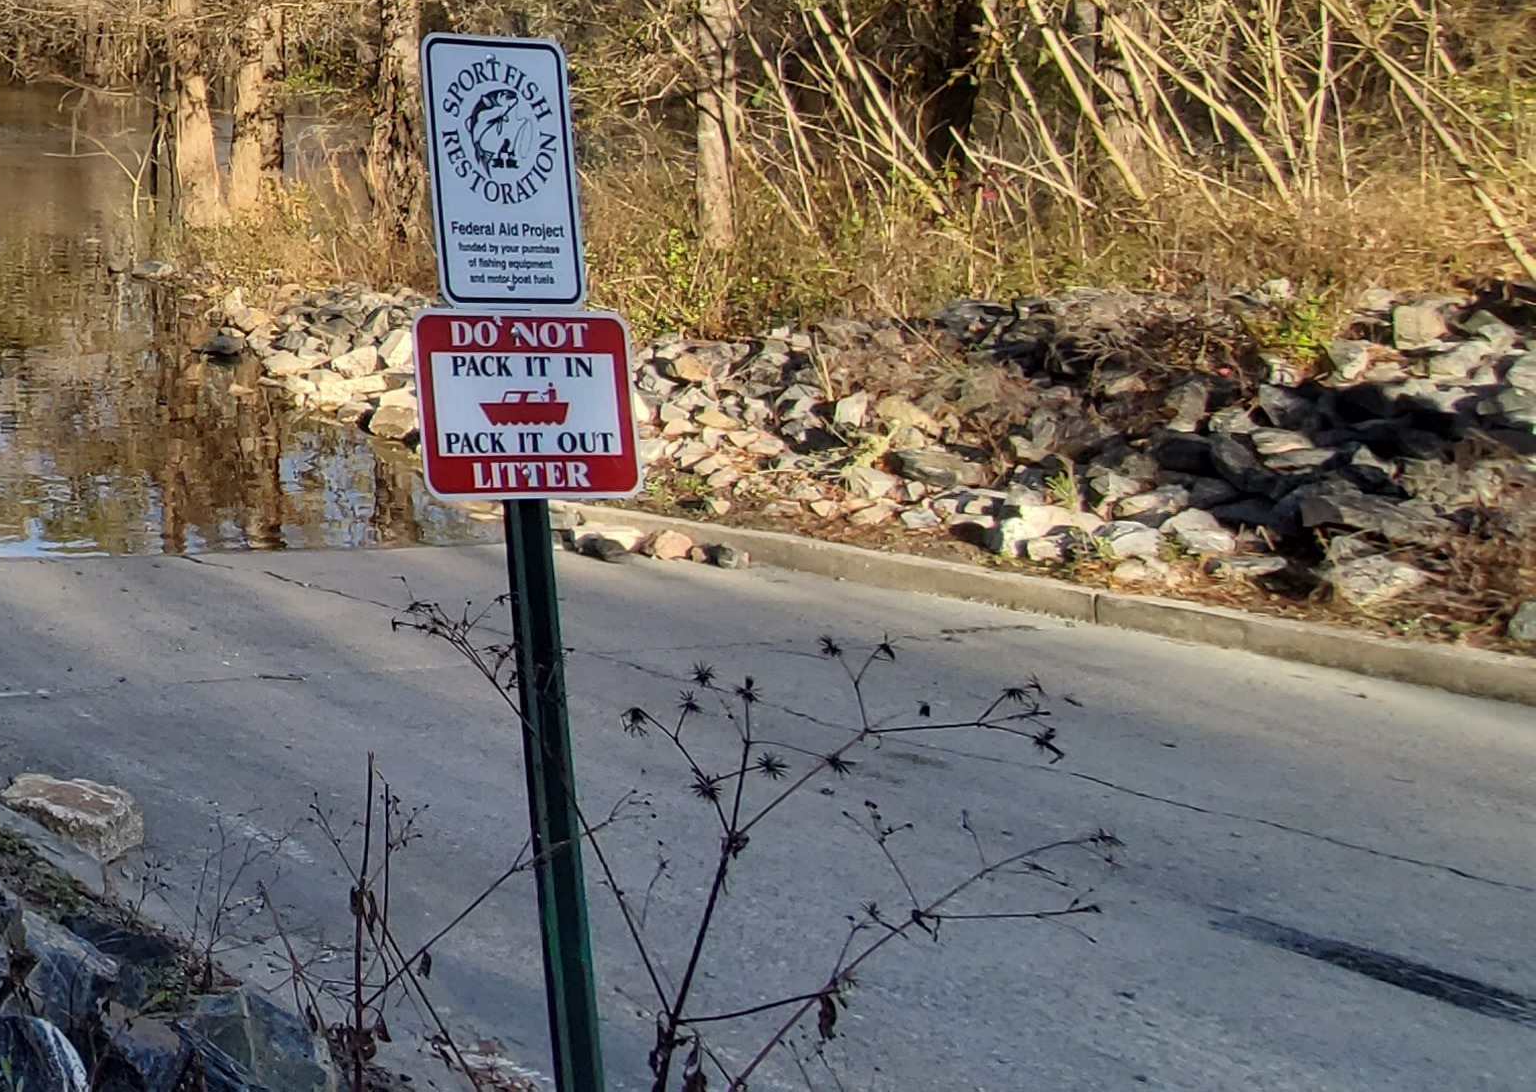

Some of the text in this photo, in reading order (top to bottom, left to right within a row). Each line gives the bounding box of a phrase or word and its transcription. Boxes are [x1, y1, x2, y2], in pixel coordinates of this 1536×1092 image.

[442, 58, 554, 123] SPORT FISH
[441, 129, 558, 205] RESTORATION
[450, 220, 565, 241] Federal Aid Project
[458, 241, 561, 257] funded by your purchase
[468, 257, 554, 272] of fishing equipment
[470, 273, 485, 285] and
[511, 273, 532, 286] boat
[533, 273, 555, 285] fuels
[450, 320, 589, 348] DO NOT
[451, 355, 594, 378] PACK IT IN
[445, 431, 615, 454] PACK IT OUT
[472, 461, 592, 489] LITTER
